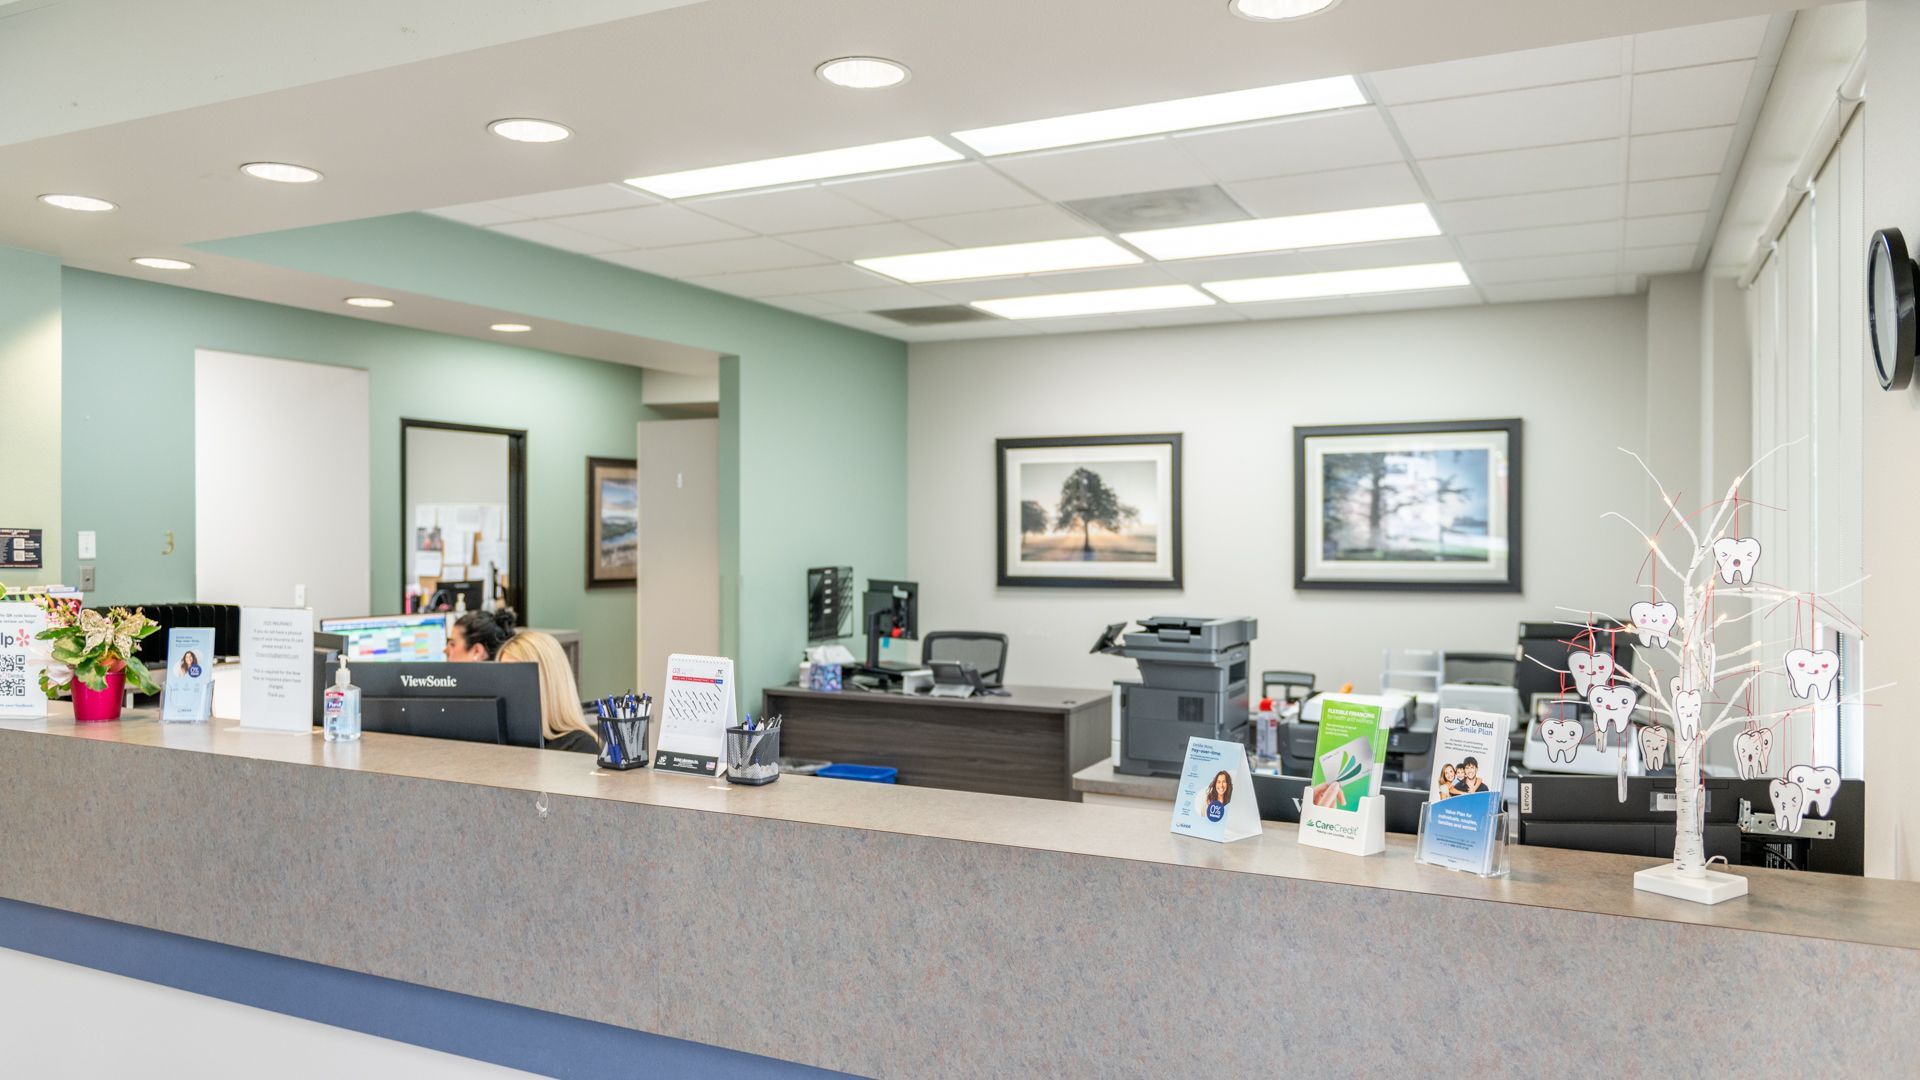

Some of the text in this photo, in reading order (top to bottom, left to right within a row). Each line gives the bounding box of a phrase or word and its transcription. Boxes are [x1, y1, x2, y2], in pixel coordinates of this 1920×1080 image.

[400, 674, 457, 688] ViewSonic
[1443, 715, 1494, 729] Gentle Dental
[1459, 726, 1493, 736] Smile Plan
[1210, 804, 1221, 814] 0%
